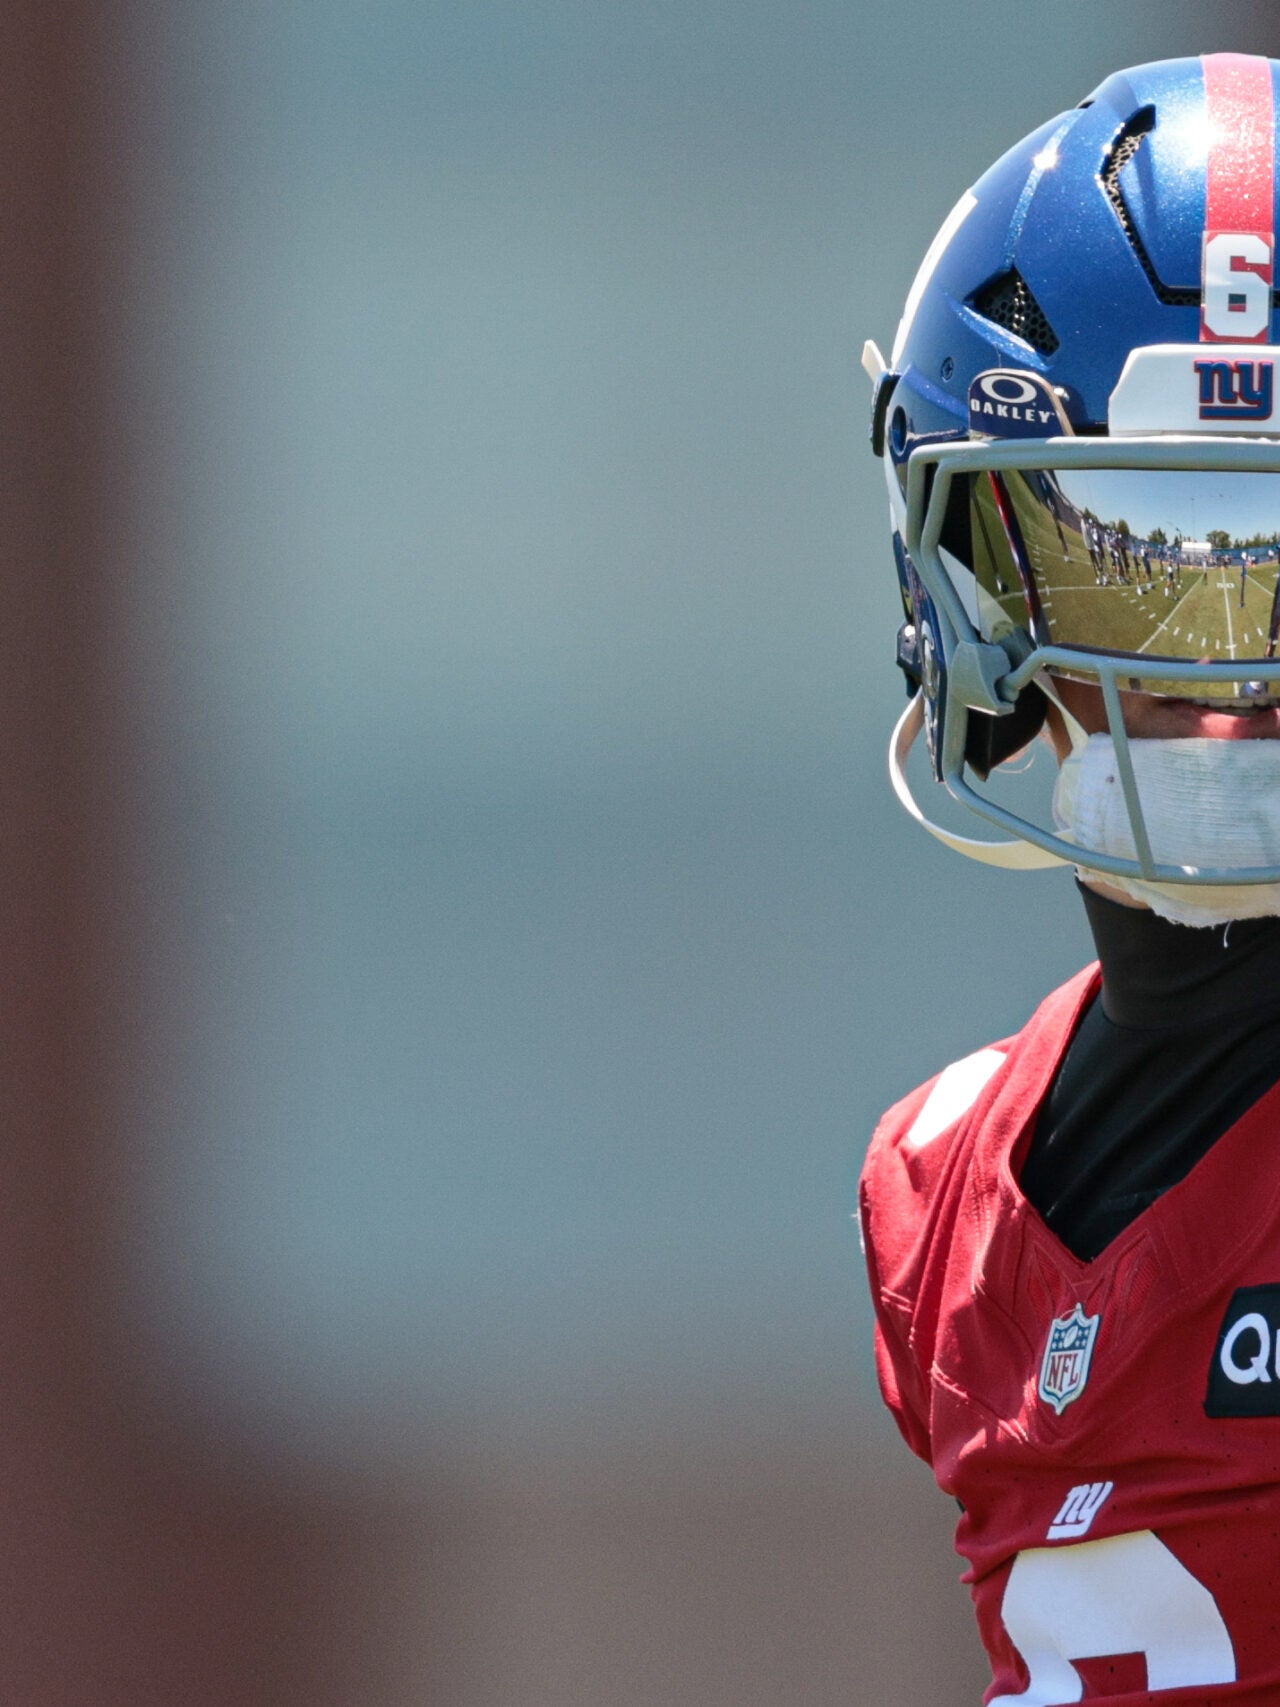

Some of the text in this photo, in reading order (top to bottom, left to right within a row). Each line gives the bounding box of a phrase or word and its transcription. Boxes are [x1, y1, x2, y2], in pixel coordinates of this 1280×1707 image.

[1204, 234, 1270, 338] 6
[970, 398, 1051, 423] OAKLEY
[1046, 1353, 1079, 1392] NFL
